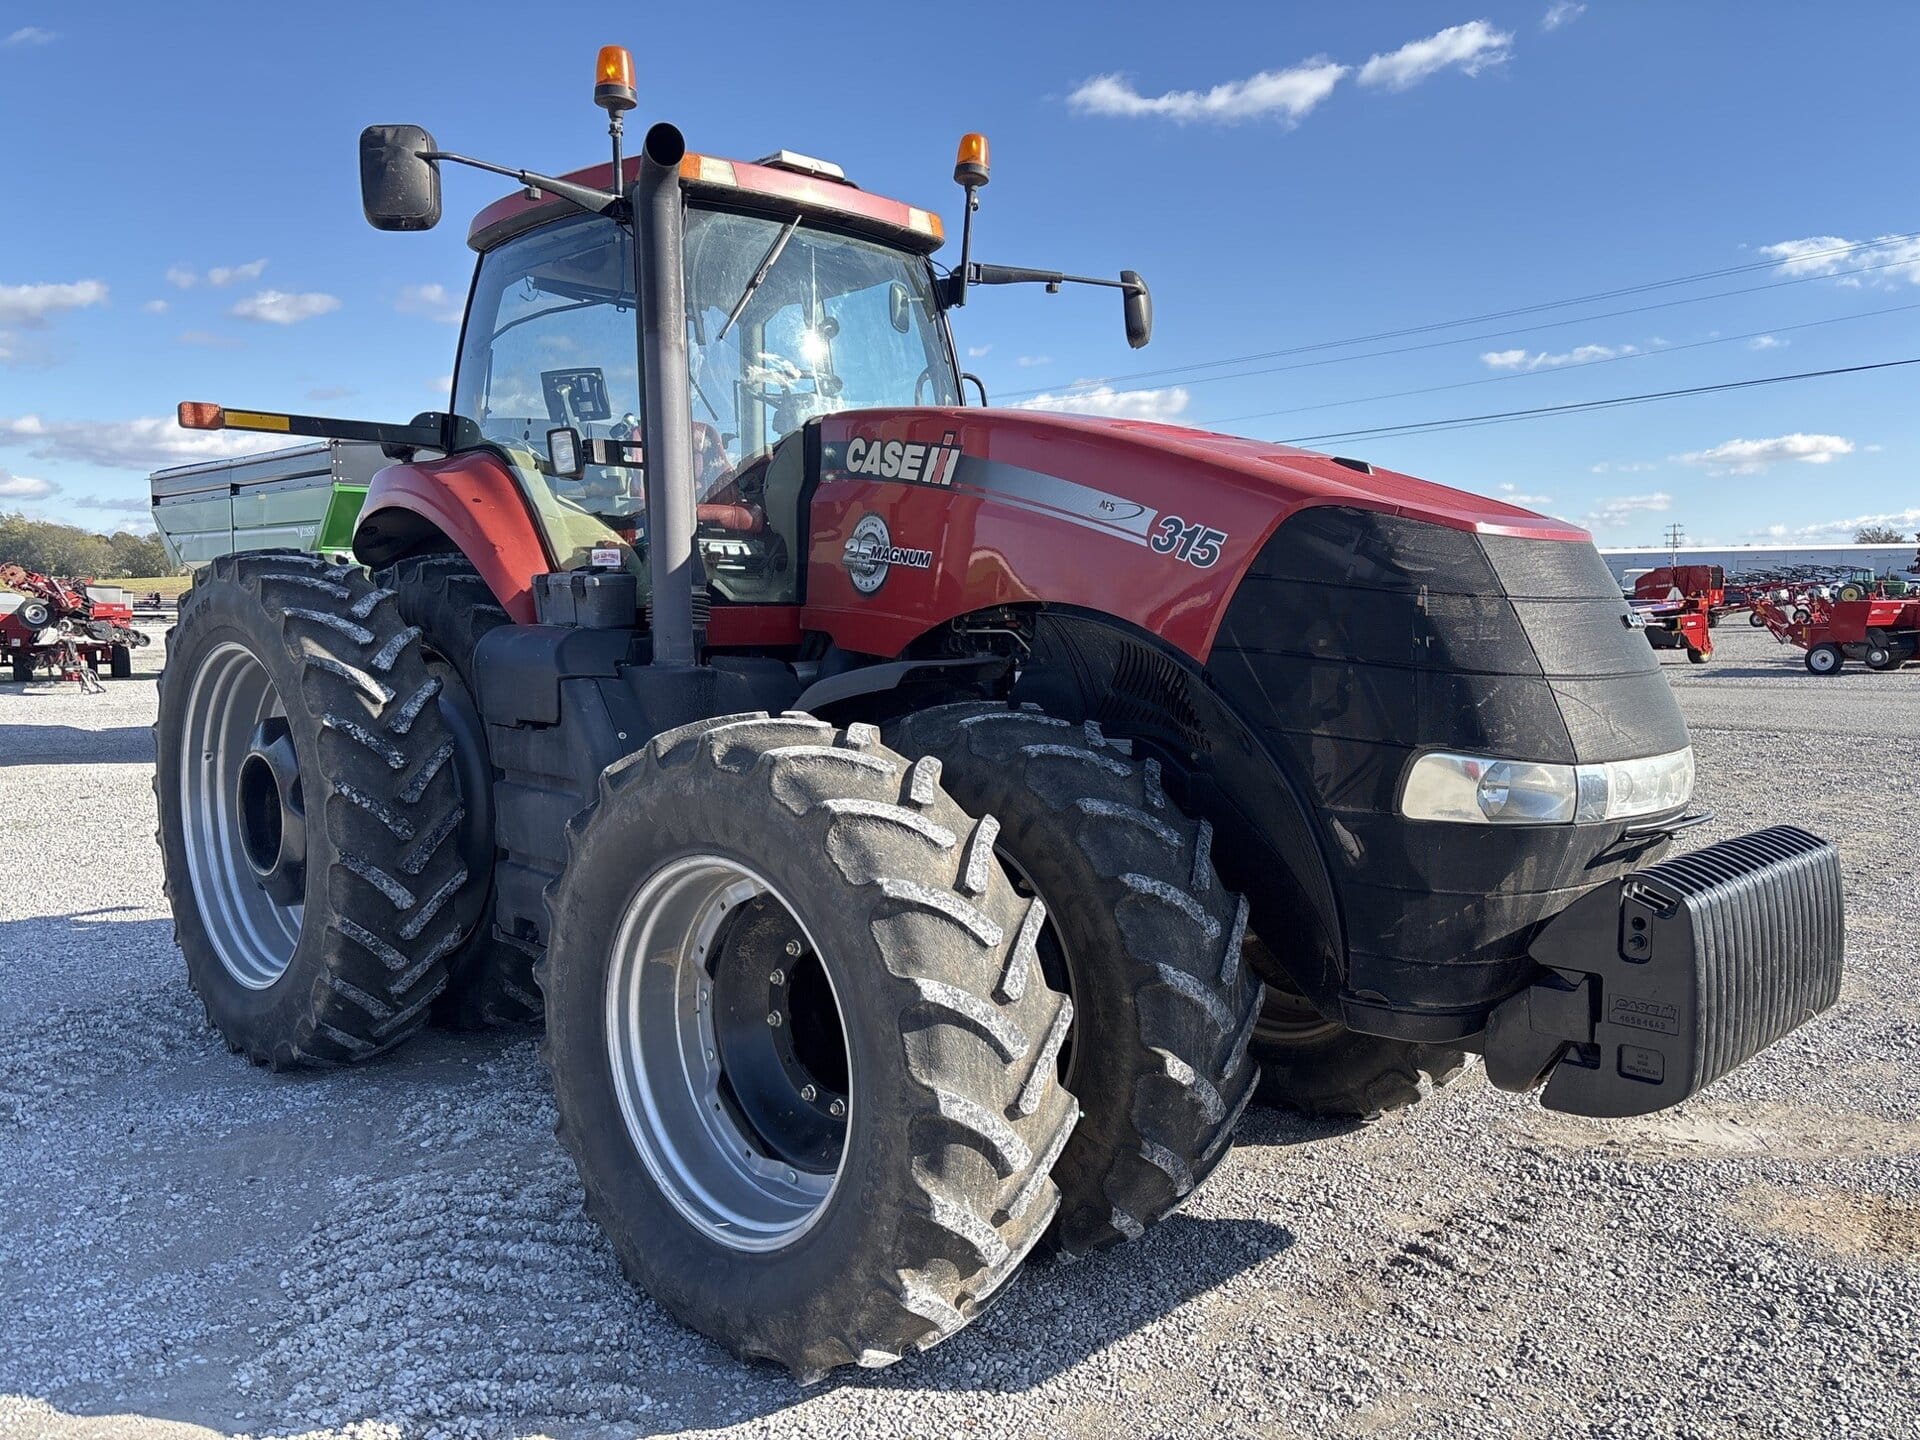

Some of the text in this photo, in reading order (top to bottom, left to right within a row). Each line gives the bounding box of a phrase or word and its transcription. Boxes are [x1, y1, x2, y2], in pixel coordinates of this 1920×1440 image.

[846, 436, 926, 481] CASE
[1098, 499, 1115, 512] AFS
[1151, 515, 1228, 569] 315
[868, 544, 933, 569] MAGNUM
[1615, 998, 1659, 1015] CASE
